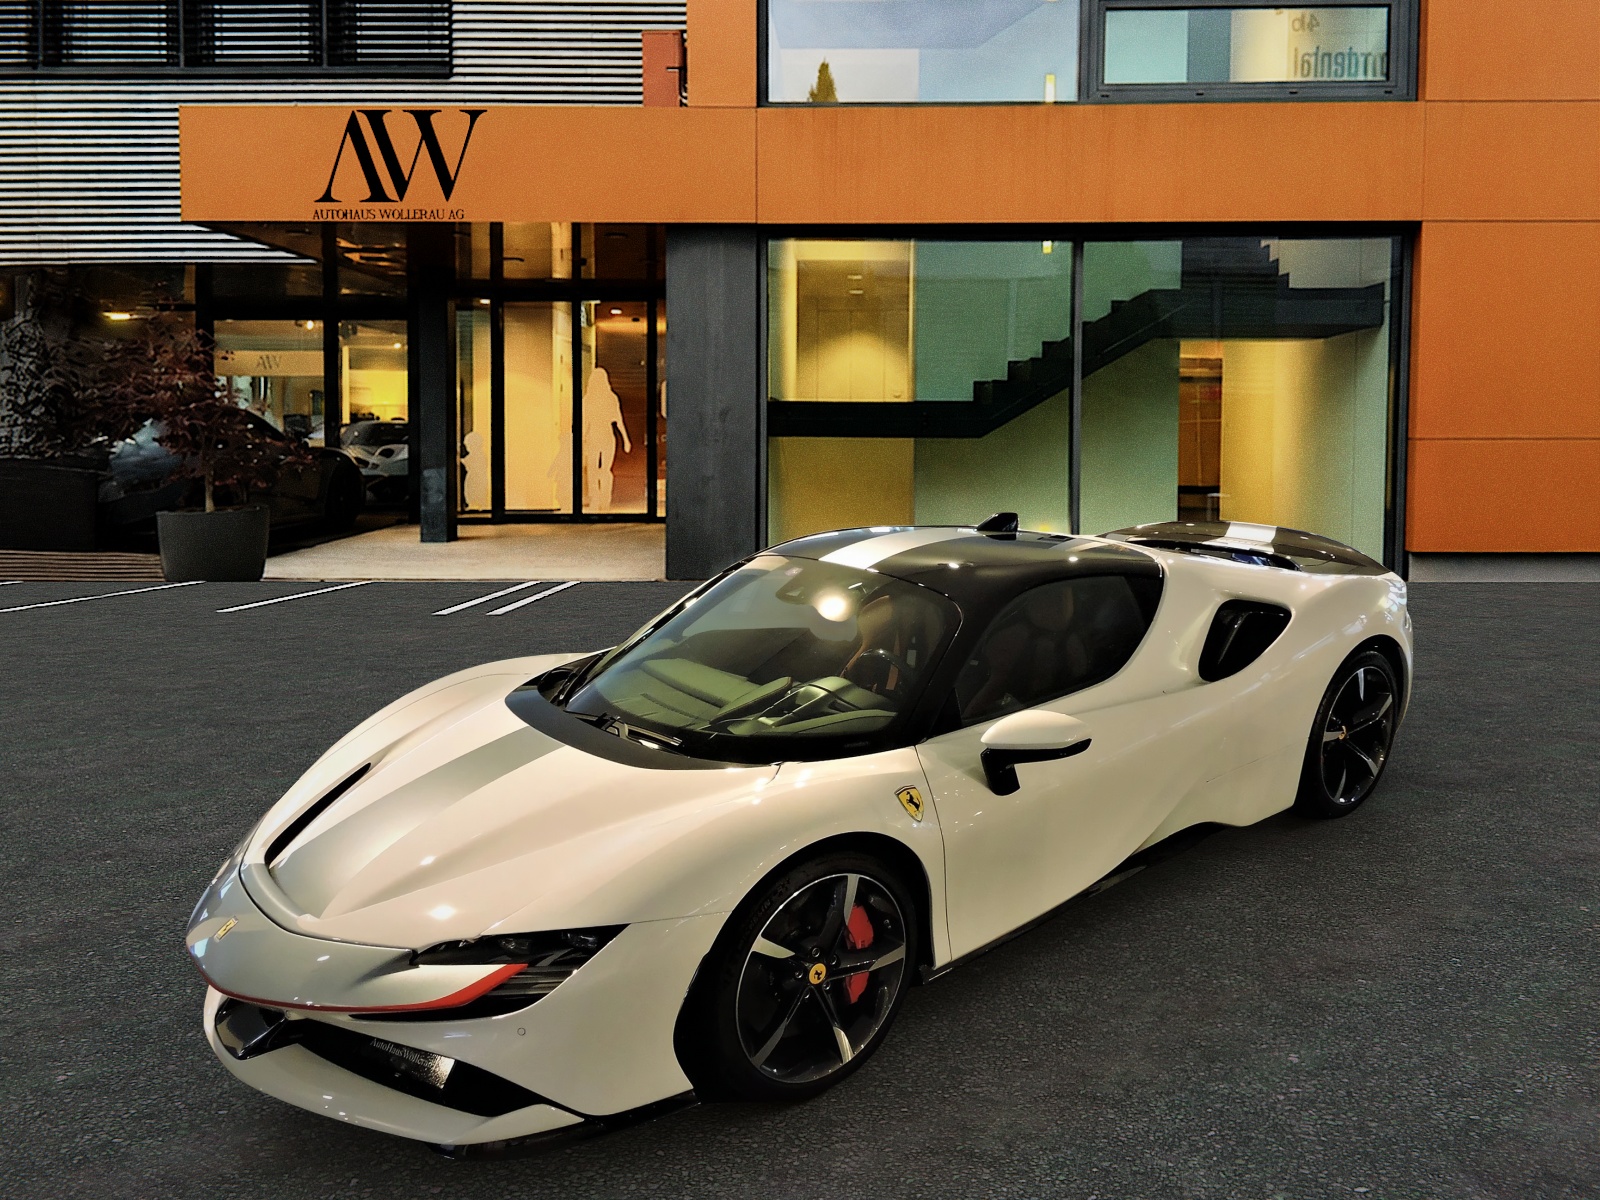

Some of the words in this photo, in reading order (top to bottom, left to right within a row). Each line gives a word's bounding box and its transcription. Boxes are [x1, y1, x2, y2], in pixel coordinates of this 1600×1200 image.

[314, 109, 488, 203] AW
[313, 209, 376, 220] AUTOHAUS
[379, 209, 445, 220] WOLLERAU
[449, 209, 465, 220] AG
